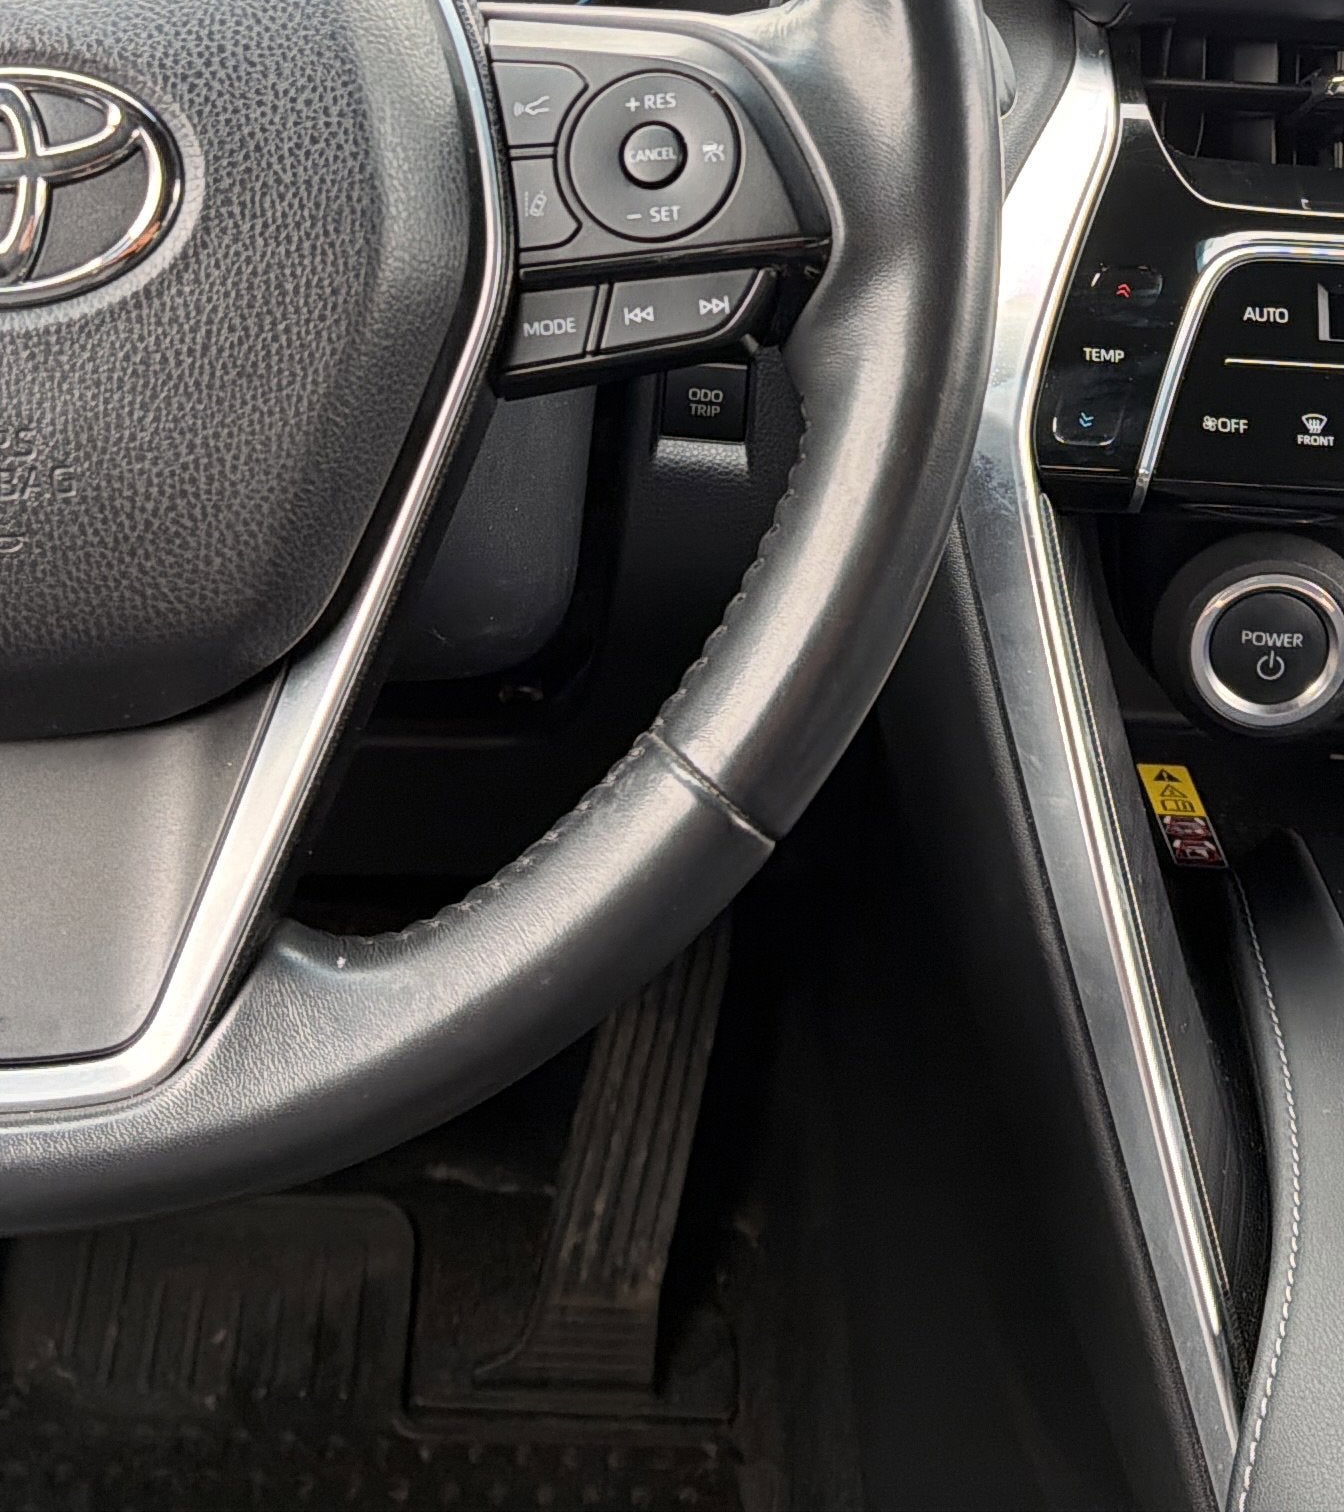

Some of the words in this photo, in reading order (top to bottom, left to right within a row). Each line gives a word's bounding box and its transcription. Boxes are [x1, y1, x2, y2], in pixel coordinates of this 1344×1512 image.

[627, 146, 676, 162] CANCEL
[1242, 306, 1289, 324] AUTO
[522, 317, 577, 337] MODE
[1082, 346, 1125, 363] TEMP
[688, 388, 724, 403] ODO
[689, 403, 721, 417] TRIP
[1217, 417, 1249, 434] OFF
[1296, 434, 1335, 447] FRONT
[1241, 630, 1304, 648] POWER
